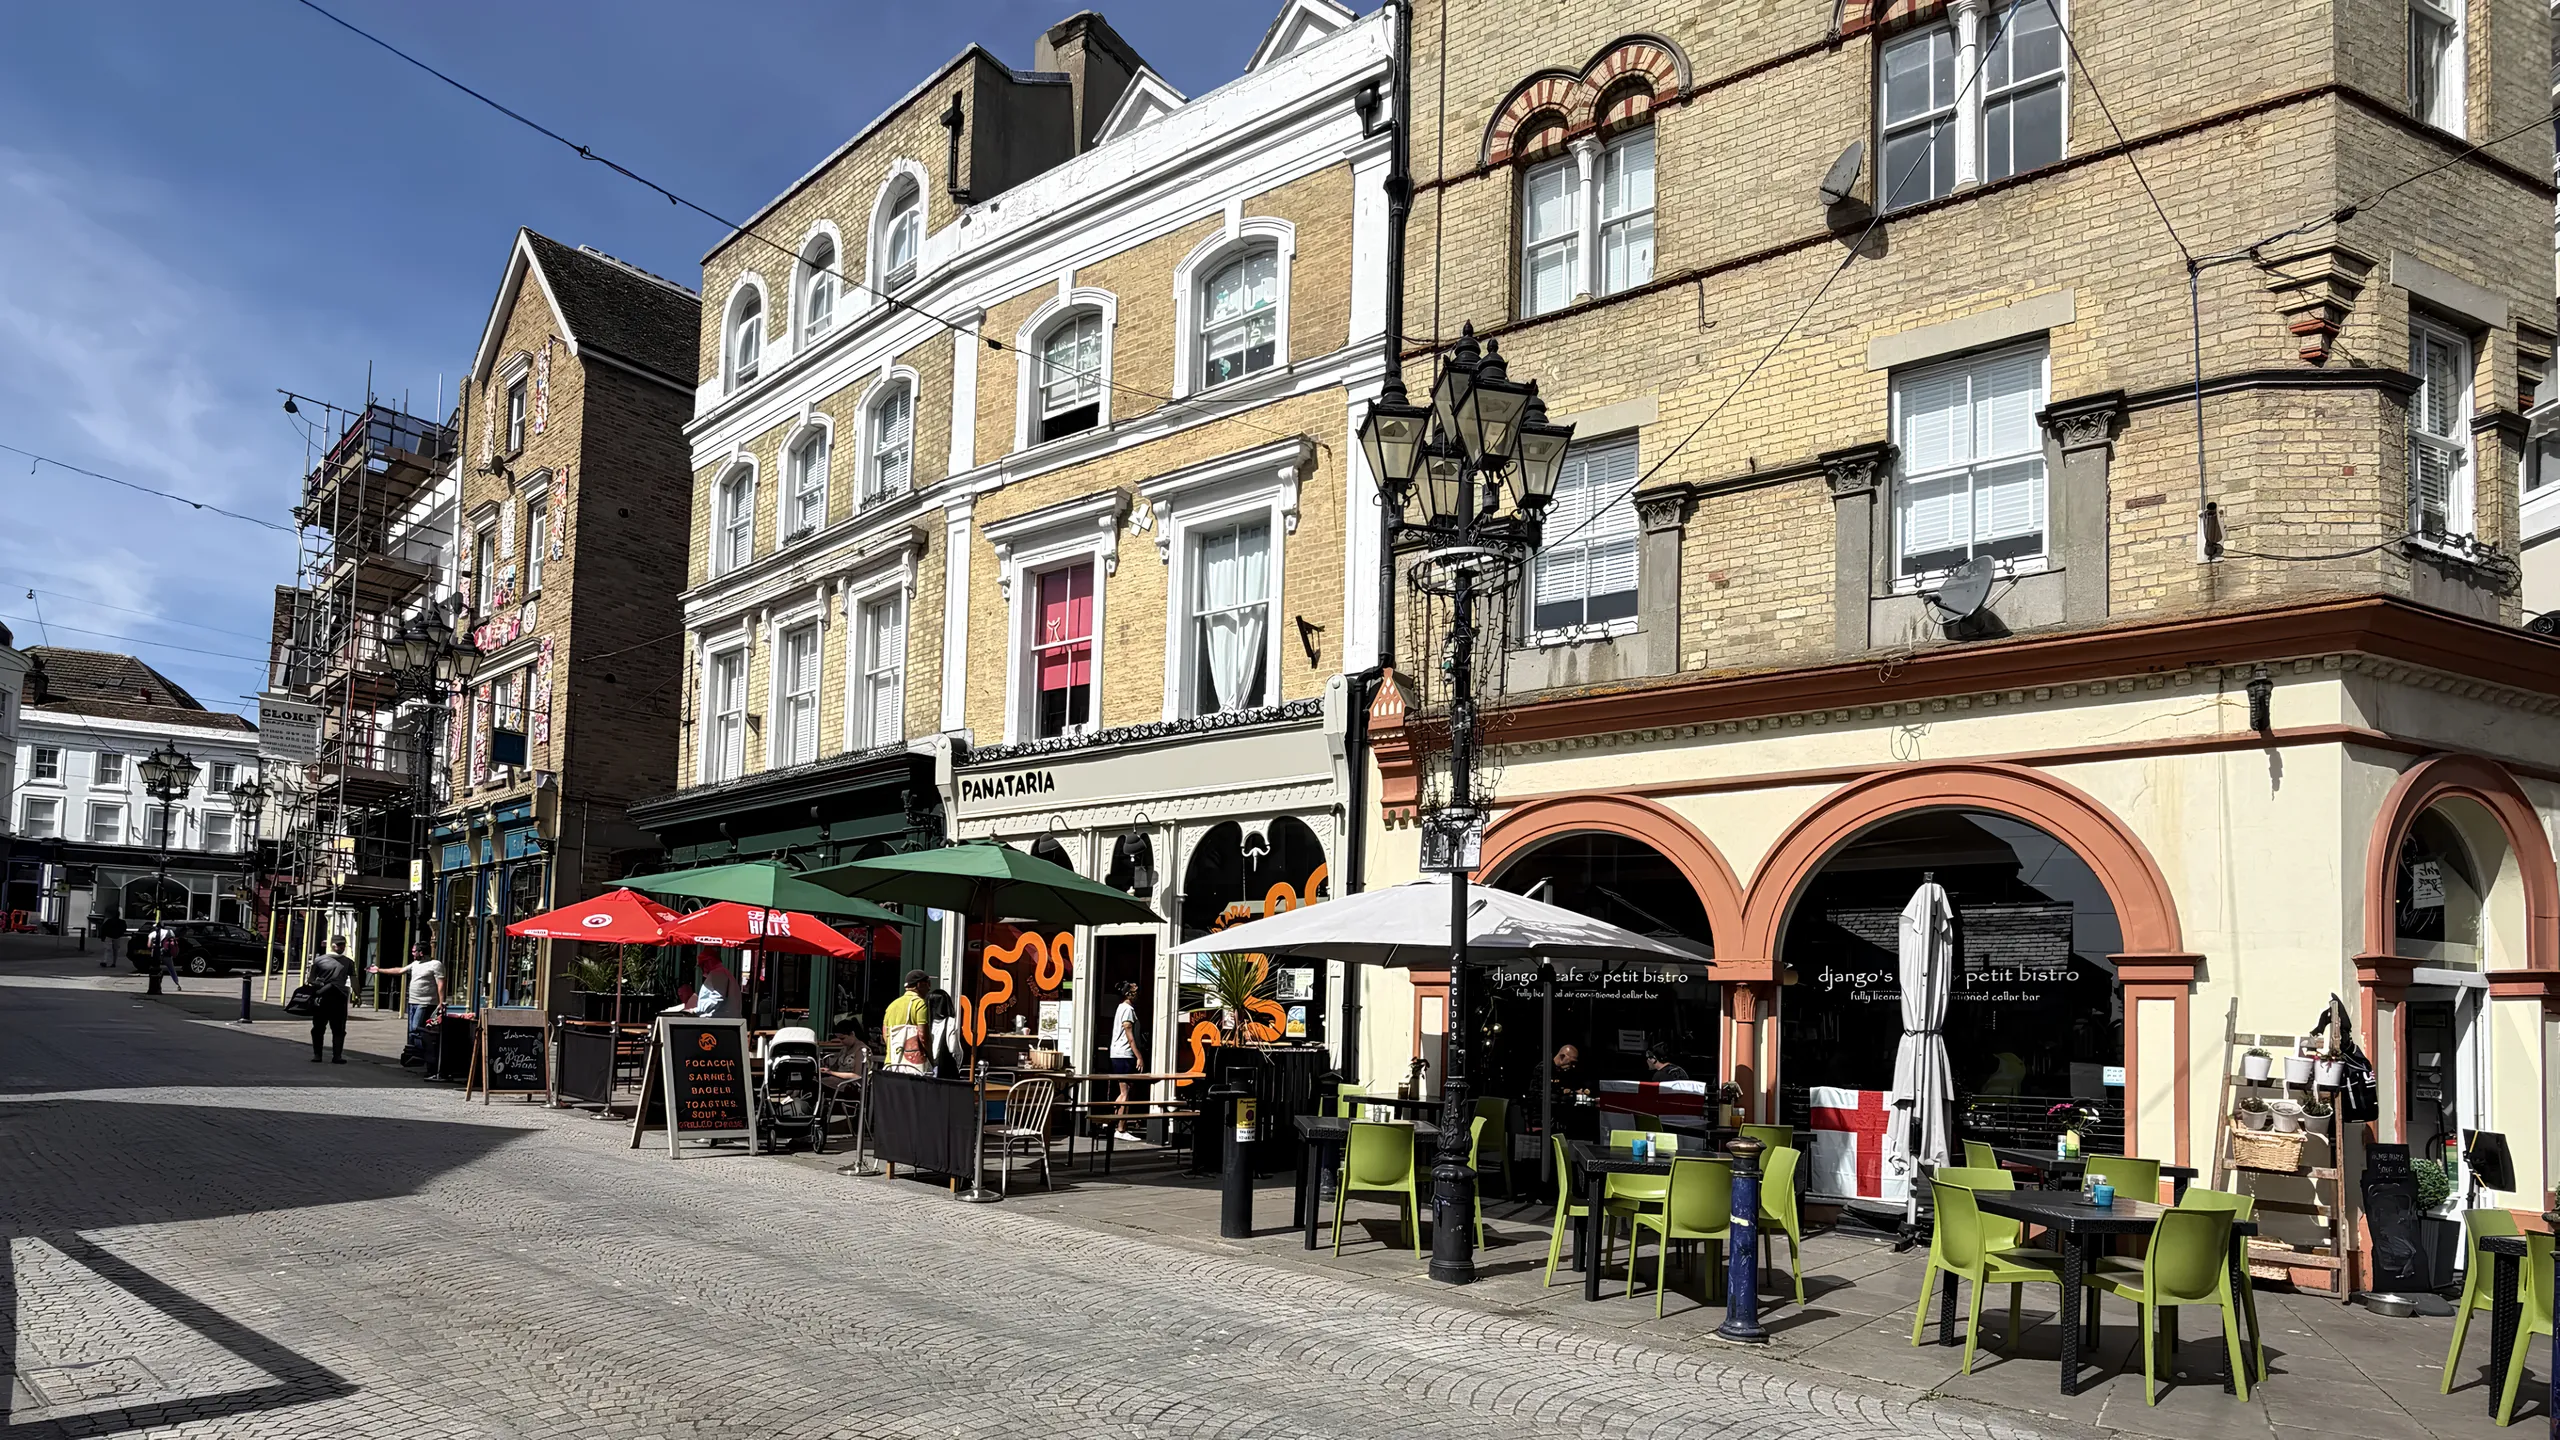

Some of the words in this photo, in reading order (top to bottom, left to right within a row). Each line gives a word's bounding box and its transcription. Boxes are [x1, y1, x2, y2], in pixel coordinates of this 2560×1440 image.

[962, 771, 1055, 802] PANATARIA
[1492, 966, 1538, 989] django
[1603, 970, 1639, 989] petit
[1643, 966, 1688, 983] bistro
[1818, 965, 1893, 992] django's
[1966, 966, 2013, 989] petit
[2019, 963, 2080, 983] bistro
[1851, 991, 1871, 1003] fully
[1991, 991, 2019, 1001] cellar
[2022, 991, 2041, 1001] bar
[685, 1059, 735, 1068] FOCACCIA
